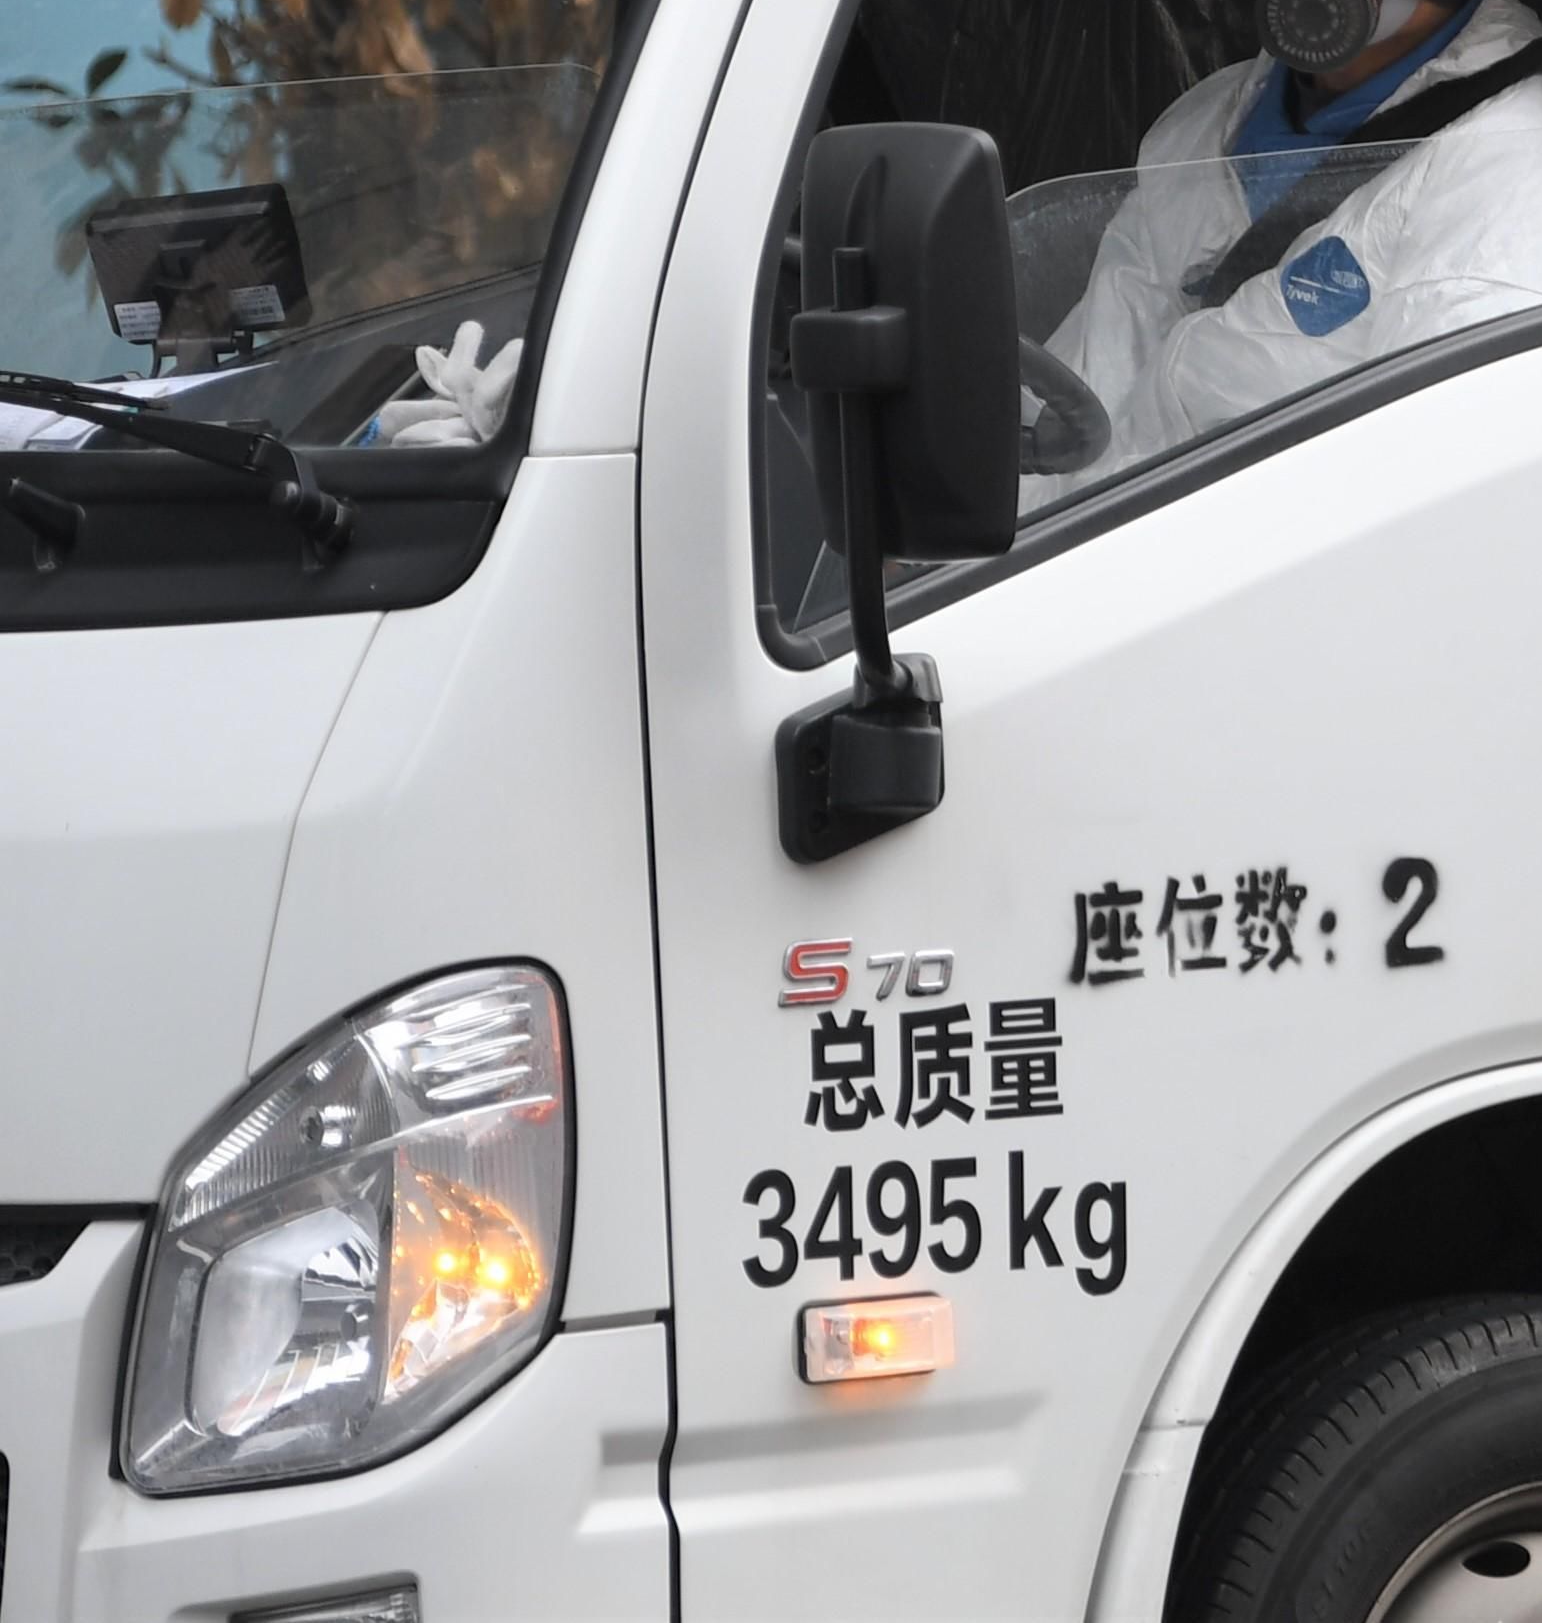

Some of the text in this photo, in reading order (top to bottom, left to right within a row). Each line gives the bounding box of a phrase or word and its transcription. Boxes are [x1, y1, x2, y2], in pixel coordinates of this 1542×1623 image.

[1286, 284, 1320, 305] Tyvek
[803, 996, 1065, 1133] 总质量
